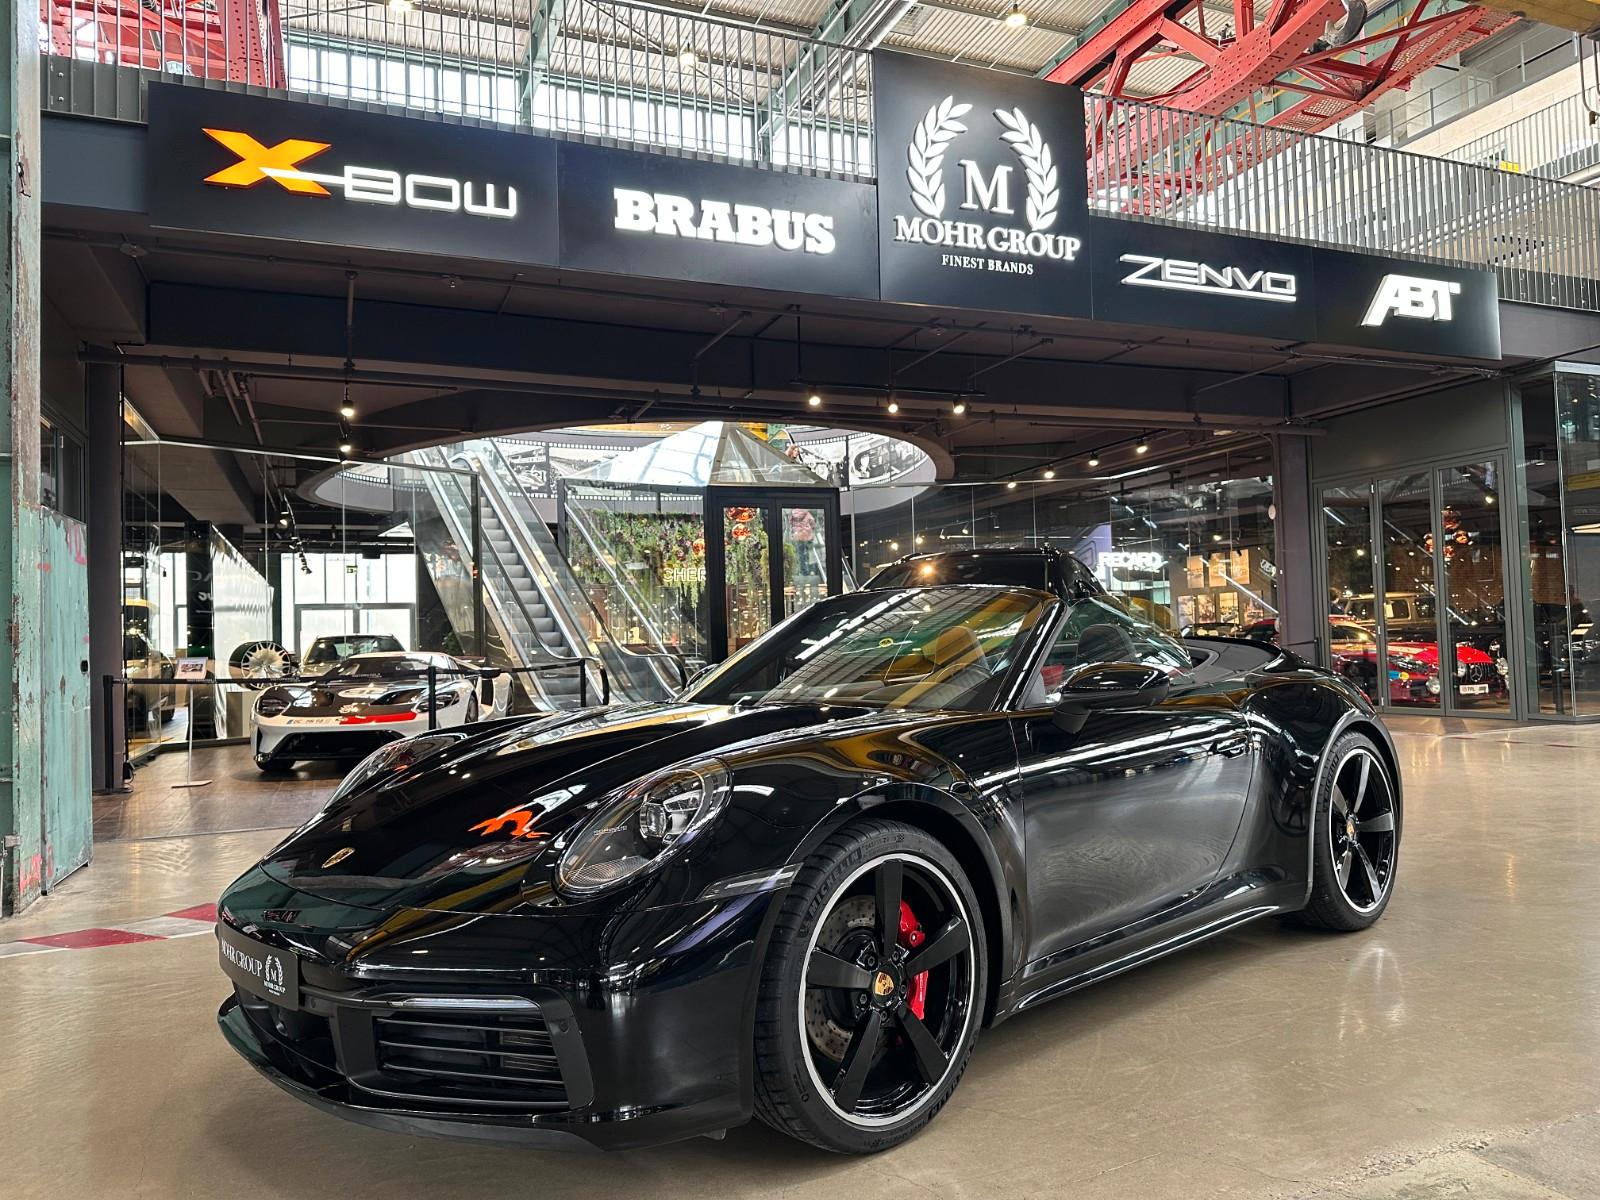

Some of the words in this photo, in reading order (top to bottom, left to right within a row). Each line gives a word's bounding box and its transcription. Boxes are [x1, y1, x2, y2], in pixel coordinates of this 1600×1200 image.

[958, 159, 1015, 214] M
[613, 187, 837, 256] BRABUS
[894, 215, 987, 251] MOHR
[986, 226, 1081, 261] GROUP
[941, 254, 985, 270] FINEST
[987, 259, 1034, 276] BRANDS
[1119, 253, 1297, 302] ZENVO
[1360, 273, 1462, 328] ABT
[806, 846, 864, 919] MICHELIN
[221, 937, 237, 964] MOHR
[235, 950, 263, 977] GROUP
